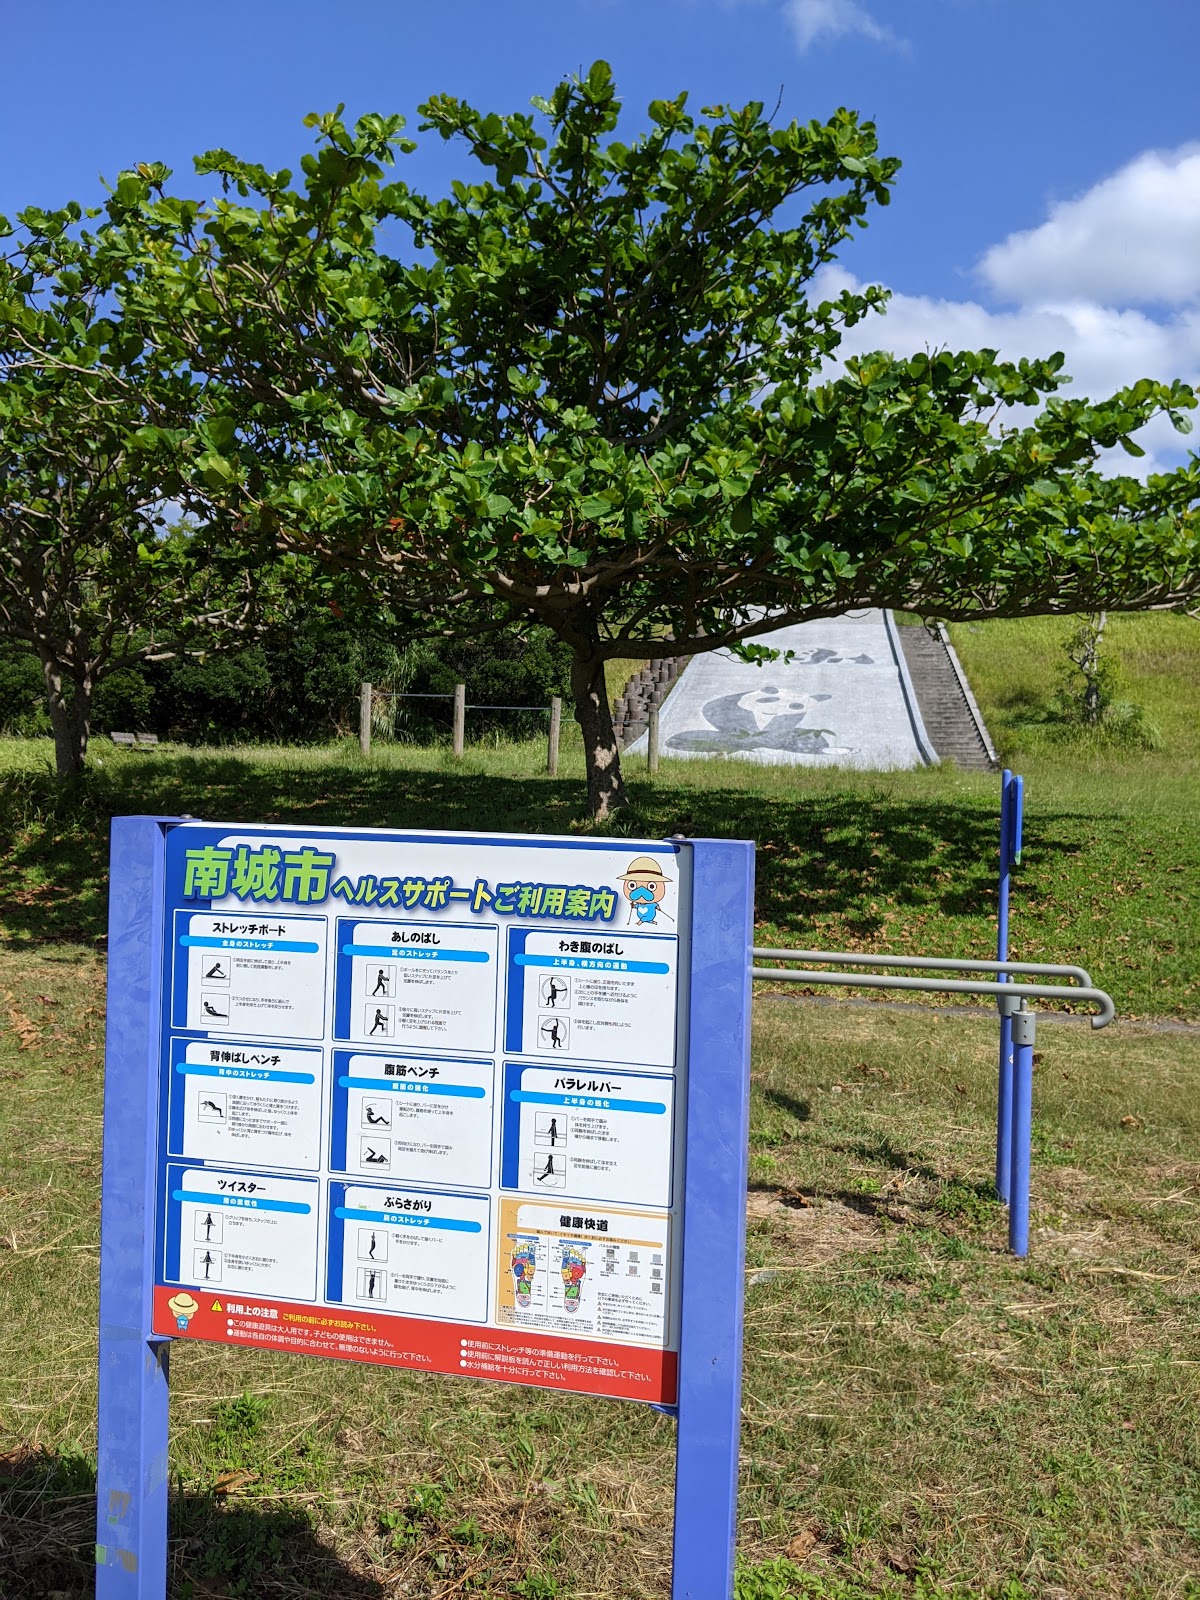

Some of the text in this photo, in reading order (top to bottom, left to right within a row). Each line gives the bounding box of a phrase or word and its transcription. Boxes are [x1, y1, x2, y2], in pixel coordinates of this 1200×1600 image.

[182, 845, 618, 919] 南城市 ヘルスサポートご利用案内
[212, 922, 286, 936] ストレッチボード
[222, 939, 274, 949] 全身のストレッチ
[391, 931, 441, 945] あしのばし
[391, 949, 439, 958] 足のストレッチ
[558, 940, 624, 955] わき腹のばし
[552, 958, 628, 970] 上半身、横方向の運動
[210, 1050, 281, 1066] 背伸ばしベンチ
[218, 1068, 270, 1079] 背中のストレッチ
[384, 1063, 440, 1078] 腹筋ベンチ
[392, 1082, 429, 1092] 腹筋の強化
[554, 1077, 622, 1093] パラレルバー
[563, 1096, 610, 1108] 上半身の強化
[217, 1179, 266, 1193] ツイスター
[384, 1196, 432, 1212] ぶらさがり
[383, 1214, 431, 1225] 肩のストレッチ
[559, 1214, 609, 1232] 健康快道
[226, 1303, 377, 1332] 利用上の注意 ご利用の前に必ずお読み下さい。
[233, 1319, 394, 1347] この健康遊具は大人用です。子どもの使用はできません。
[233, 1329, 432, 1363] 運動は各自の体調や目的に合わせて、無理のないように行って下さい。
[467, 1340, 620, 1367] 使用前にストレッチ等の準備運動を行って下さい。
[466, 1350, 653, 1382] 使用前に解説板を読んで正しい利用方法を確認して下さい。
[466, 1360, 567, 1381] 水分補給を十分に行って下さい。
